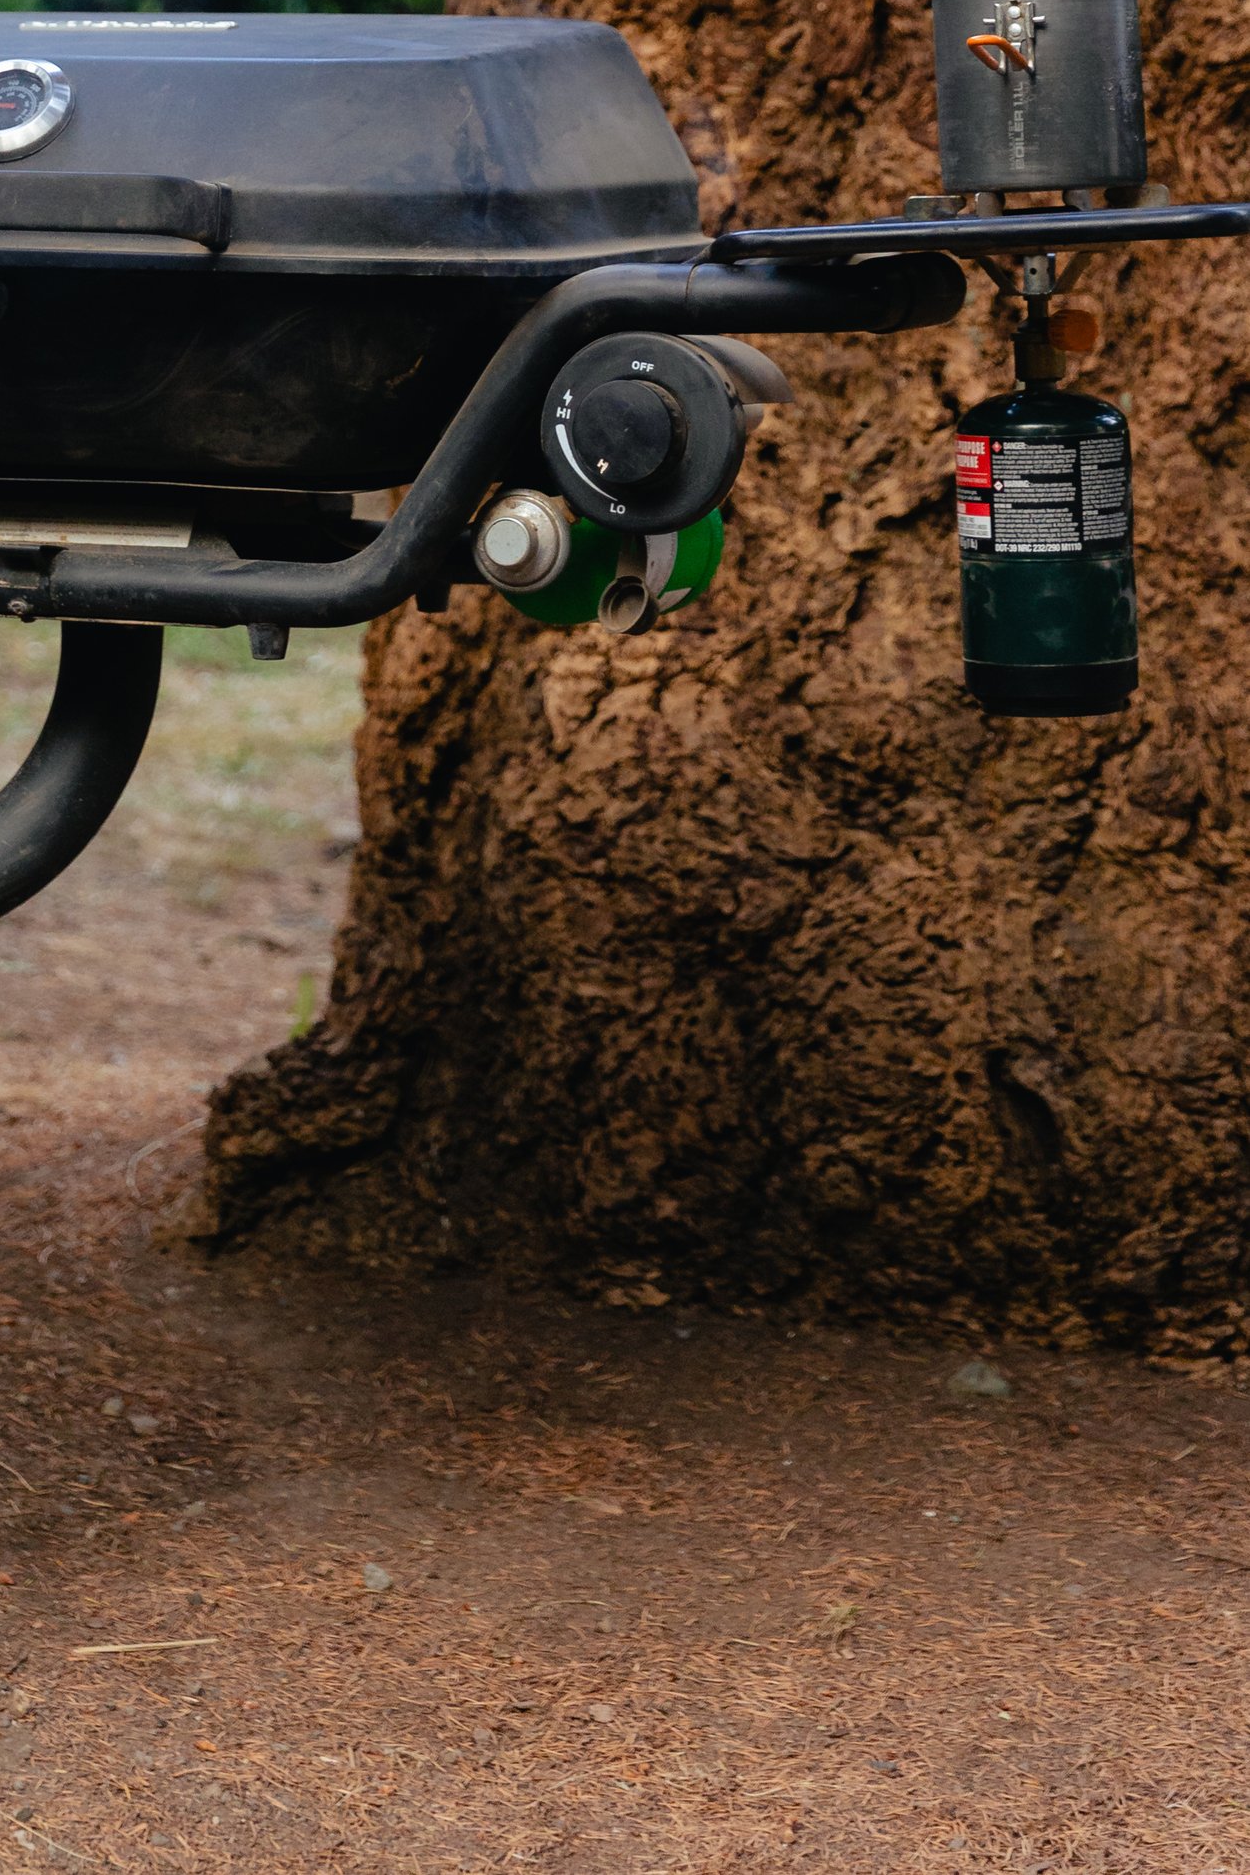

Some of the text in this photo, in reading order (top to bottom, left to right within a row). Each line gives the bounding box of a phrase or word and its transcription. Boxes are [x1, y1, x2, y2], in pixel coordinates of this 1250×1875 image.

[1013, 110, 1025, 170] BOILER
[631, 360, 654, 372] OFF
[556, 407, 571, 419] HI
[609, 503, 626, 515] LO
